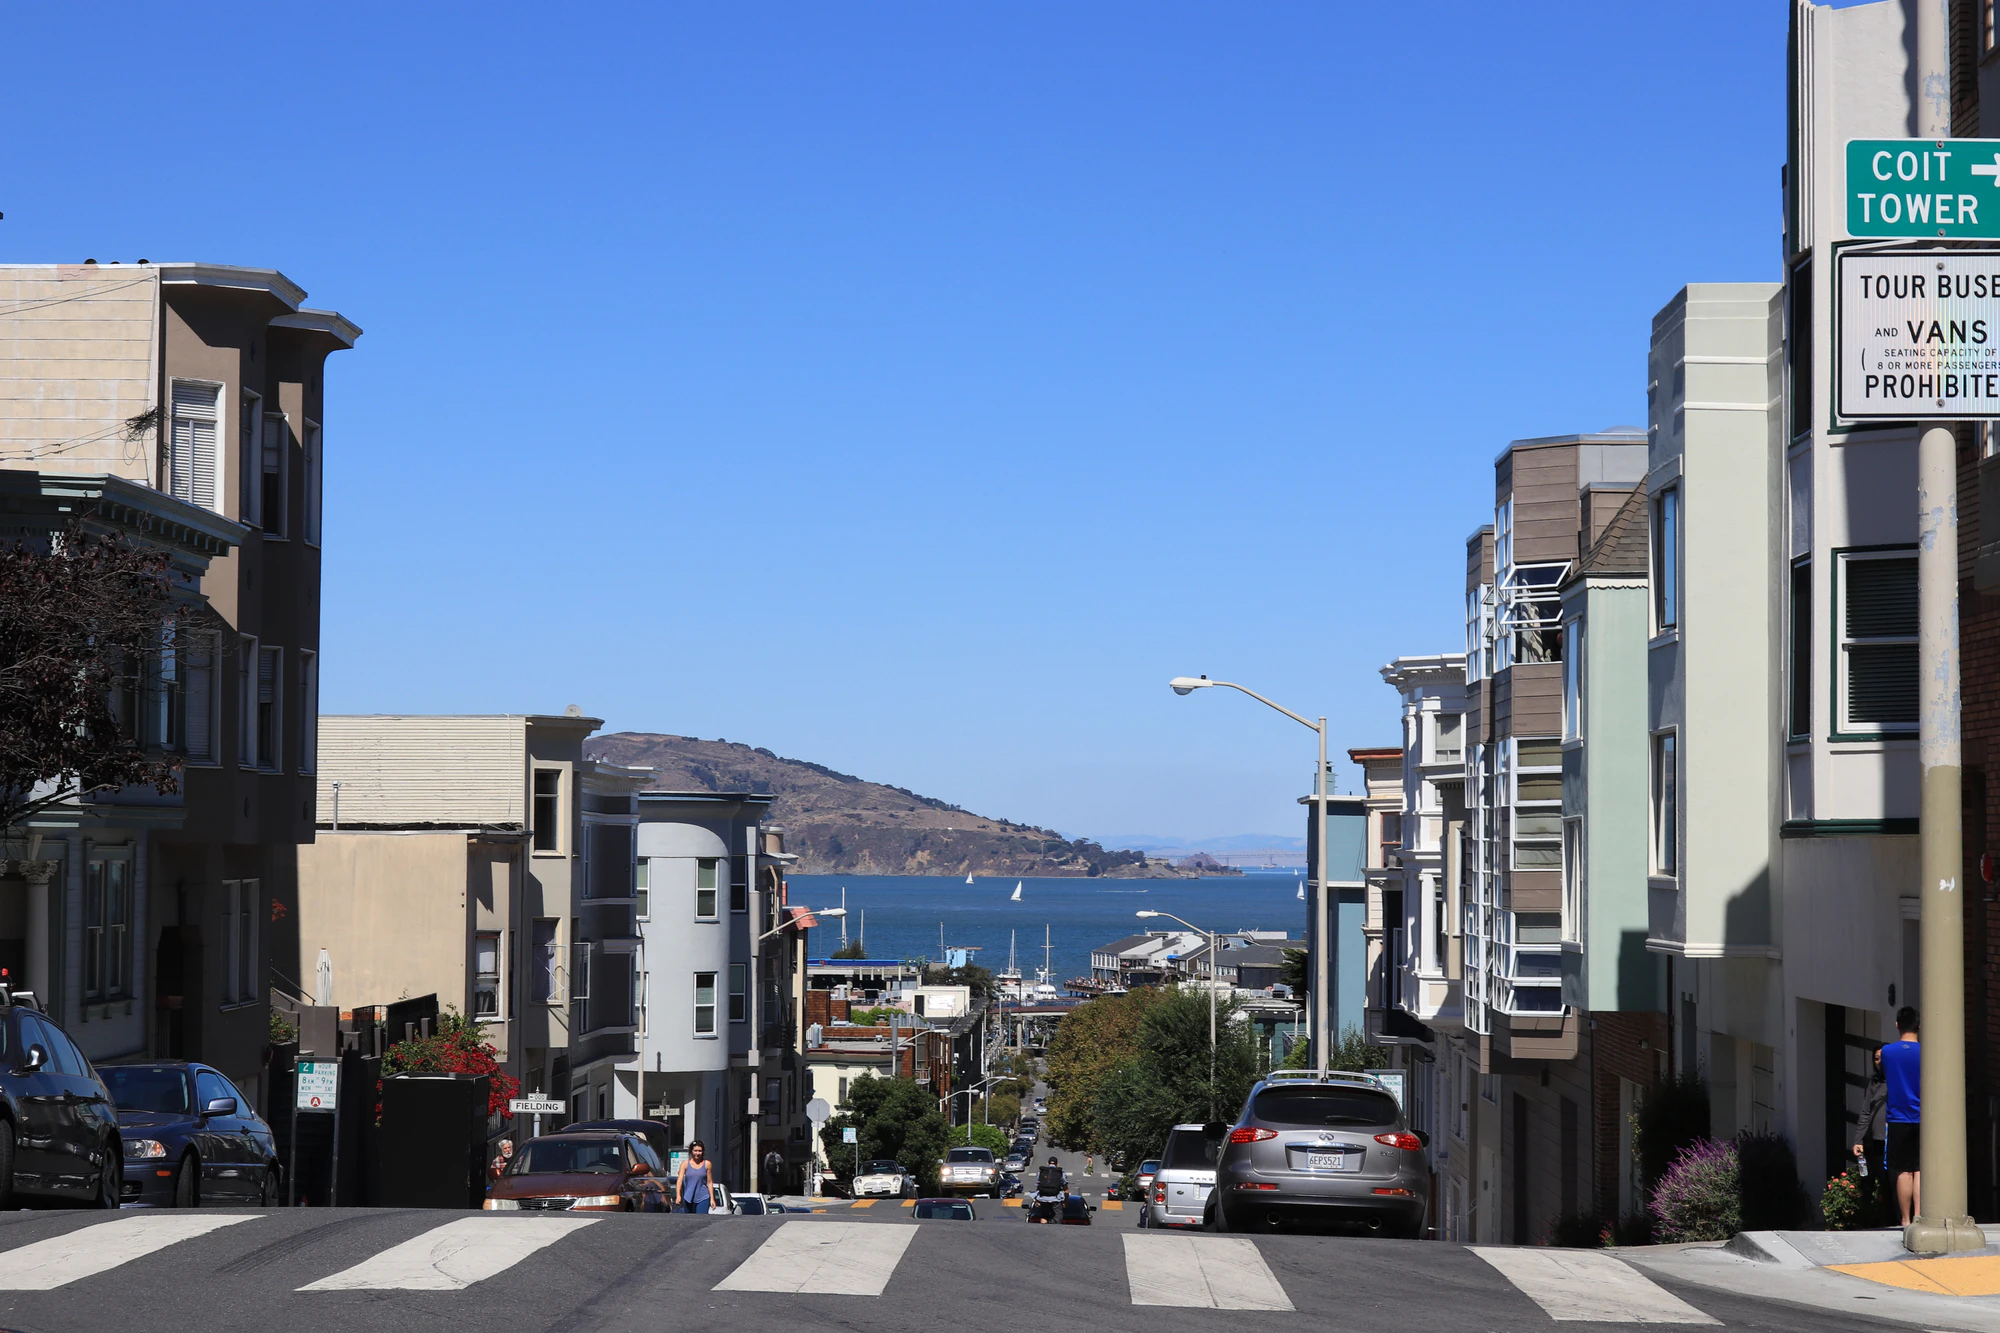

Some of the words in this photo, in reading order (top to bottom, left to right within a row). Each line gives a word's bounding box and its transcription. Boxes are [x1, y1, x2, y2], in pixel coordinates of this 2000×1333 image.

[1872, 151, 1952, 181] COIT
[1857, 193, 1979, 224] TOWER
[1860, 274, 1926, 299] TOUR
[1875, 327, 1898, 337] AND
[1906, 320, 1988, 344] VANS
[1884, 348, 1926, 357] SEATING
[1930, 348, 1980, 357] CAPACITY
[1984, 348, 1997, 357] OF
[1877, 361, 1884, 370] 8
[1888, 361, 1901, 370] OR
[1905, 361, 1933, 370] MORE
[302, 1062, 310, 1072] 2
[516, 1102, 559, 1111] FIELDING
[1309, 1155, 1341, 1166] 6EPS521
